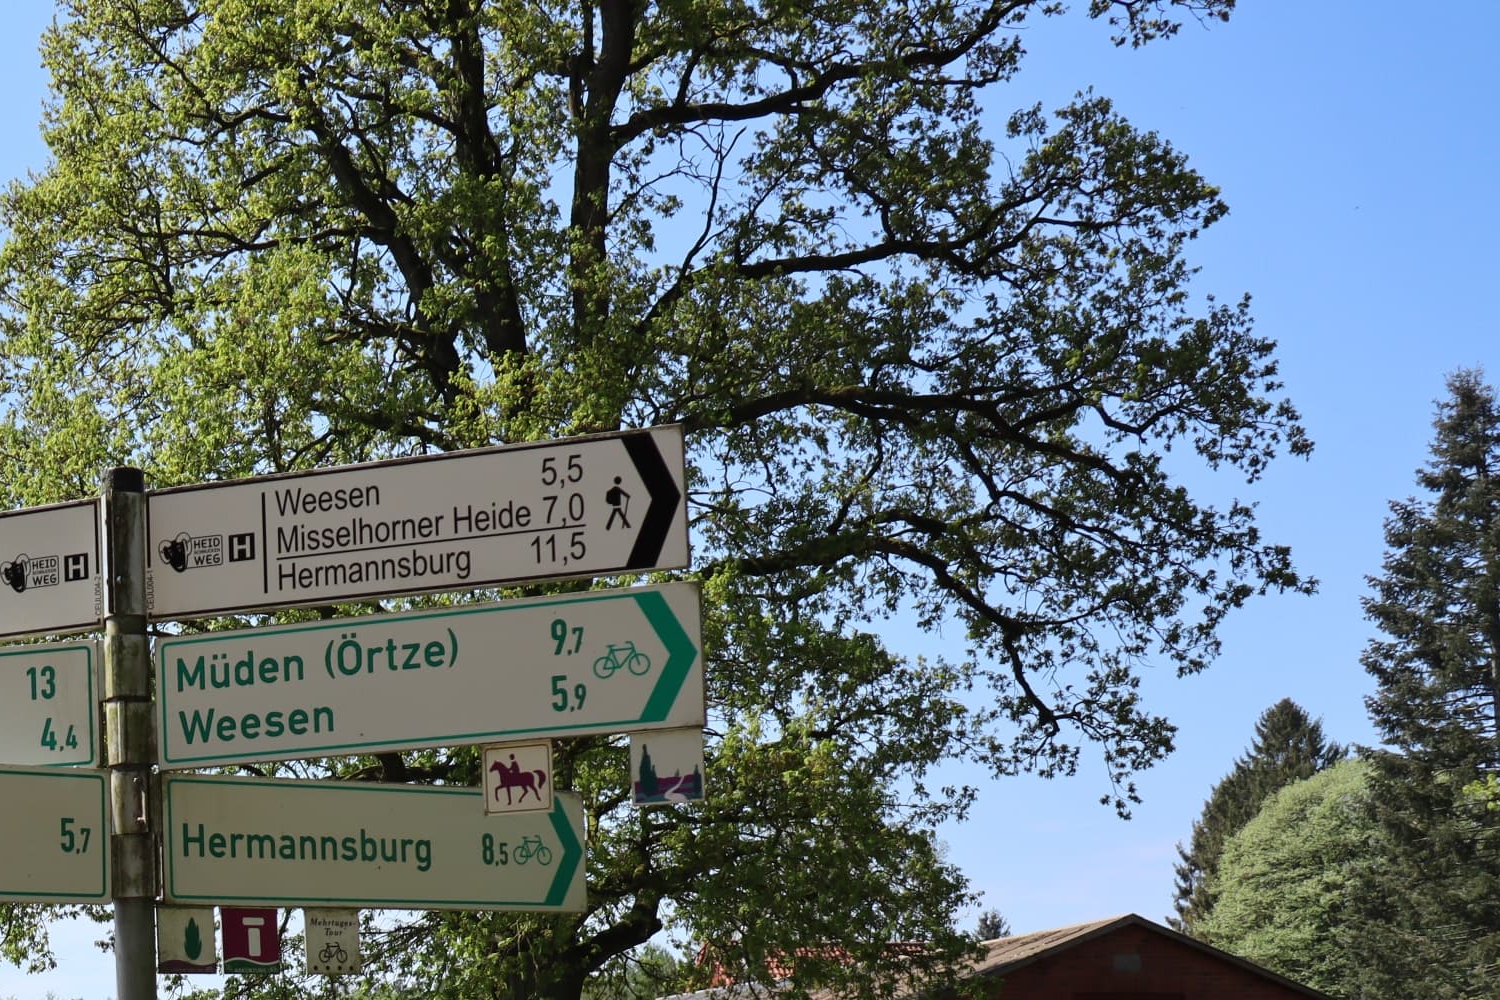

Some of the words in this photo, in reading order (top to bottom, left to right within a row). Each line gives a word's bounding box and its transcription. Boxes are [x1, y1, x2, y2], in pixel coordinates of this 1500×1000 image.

[275, 484, 381, 517] Weesen
[541, 454, 584, 488] 5,5
[277, 512, 444, 555] Misselhorner
[453, 496, 532, 534] Heide
[543, 492, 585, 528] 7,0
[194, 537, 221, 549] HEID
[194, 553, 221, 566] WEG
[278, 547, 471, 592] Hermannsburg
[531, 531, 587, 567] 11,5
[32, 558, 57, 570] HEID
[32, 573, 57, 586] WEG
[177, 650, 305, 692] Müden
[324, 627, 459, 680] (Örtze)
[26, 665, 56, 700] 13
[179, 705, 335, 744] Weesen
[182, 823, 431, 871] Hermannsburg
[325, 927, 343, 937] Tour
